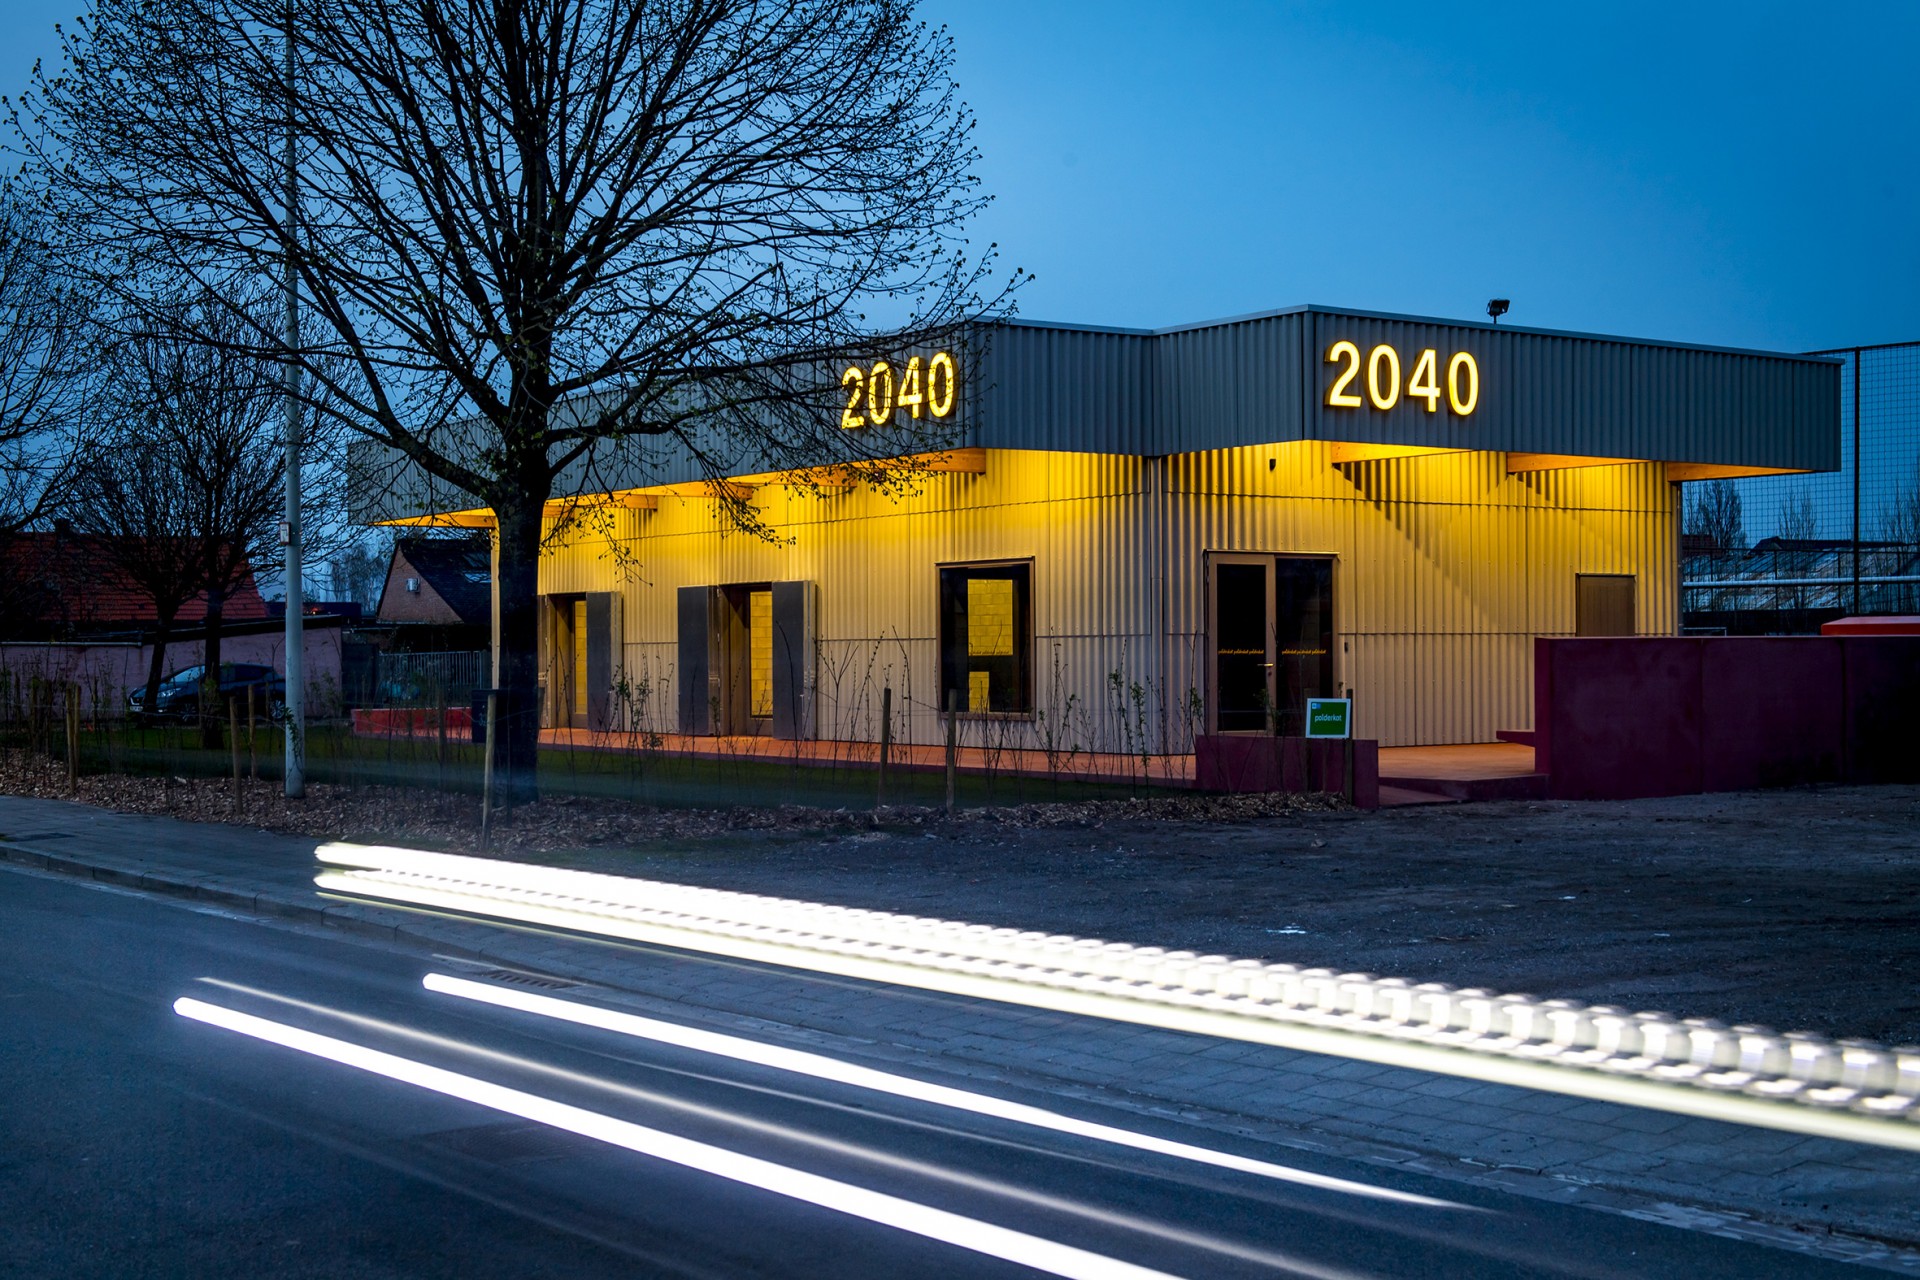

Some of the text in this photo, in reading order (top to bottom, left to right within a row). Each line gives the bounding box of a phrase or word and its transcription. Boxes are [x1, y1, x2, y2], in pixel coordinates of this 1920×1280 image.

[841, 352, 955, 429] 2040
[1328, 340, 1479, 416] 2040
[1314, 713, 1342, 722] polderkot
